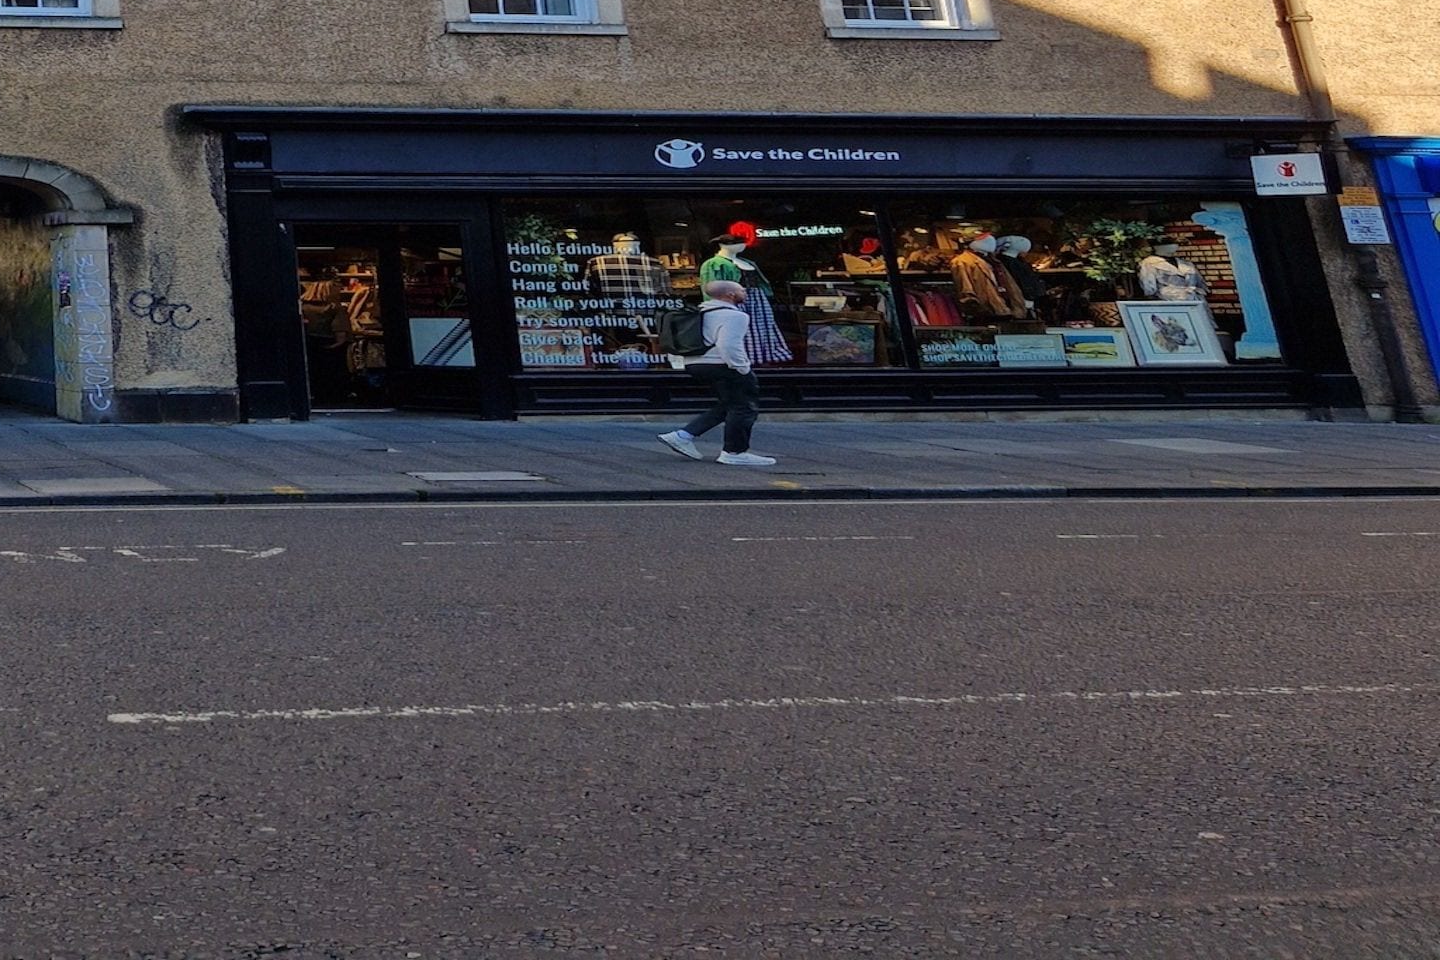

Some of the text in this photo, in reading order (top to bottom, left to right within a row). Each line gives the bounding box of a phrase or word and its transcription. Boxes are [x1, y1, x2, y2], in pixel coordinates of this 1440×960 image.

[712, 147, 900, 161] Save the Children
[755, 225, 844, 238] Save the Children
[509, 261, 579, 274] Come in
[512, 278, 590, 292] Hang out
[514, 296, 684, 312] Roll up your sleeves
[517, 316, 545, 330] Try
[549, 315, 639, 329] something
[520, 333, 604, 346] Give back
[921, 343, 950, 353] SHOP
[951, 343, 980, 353] MORE
[522, 352, 586, 367] Change
[592, 351, 620, 363] the
